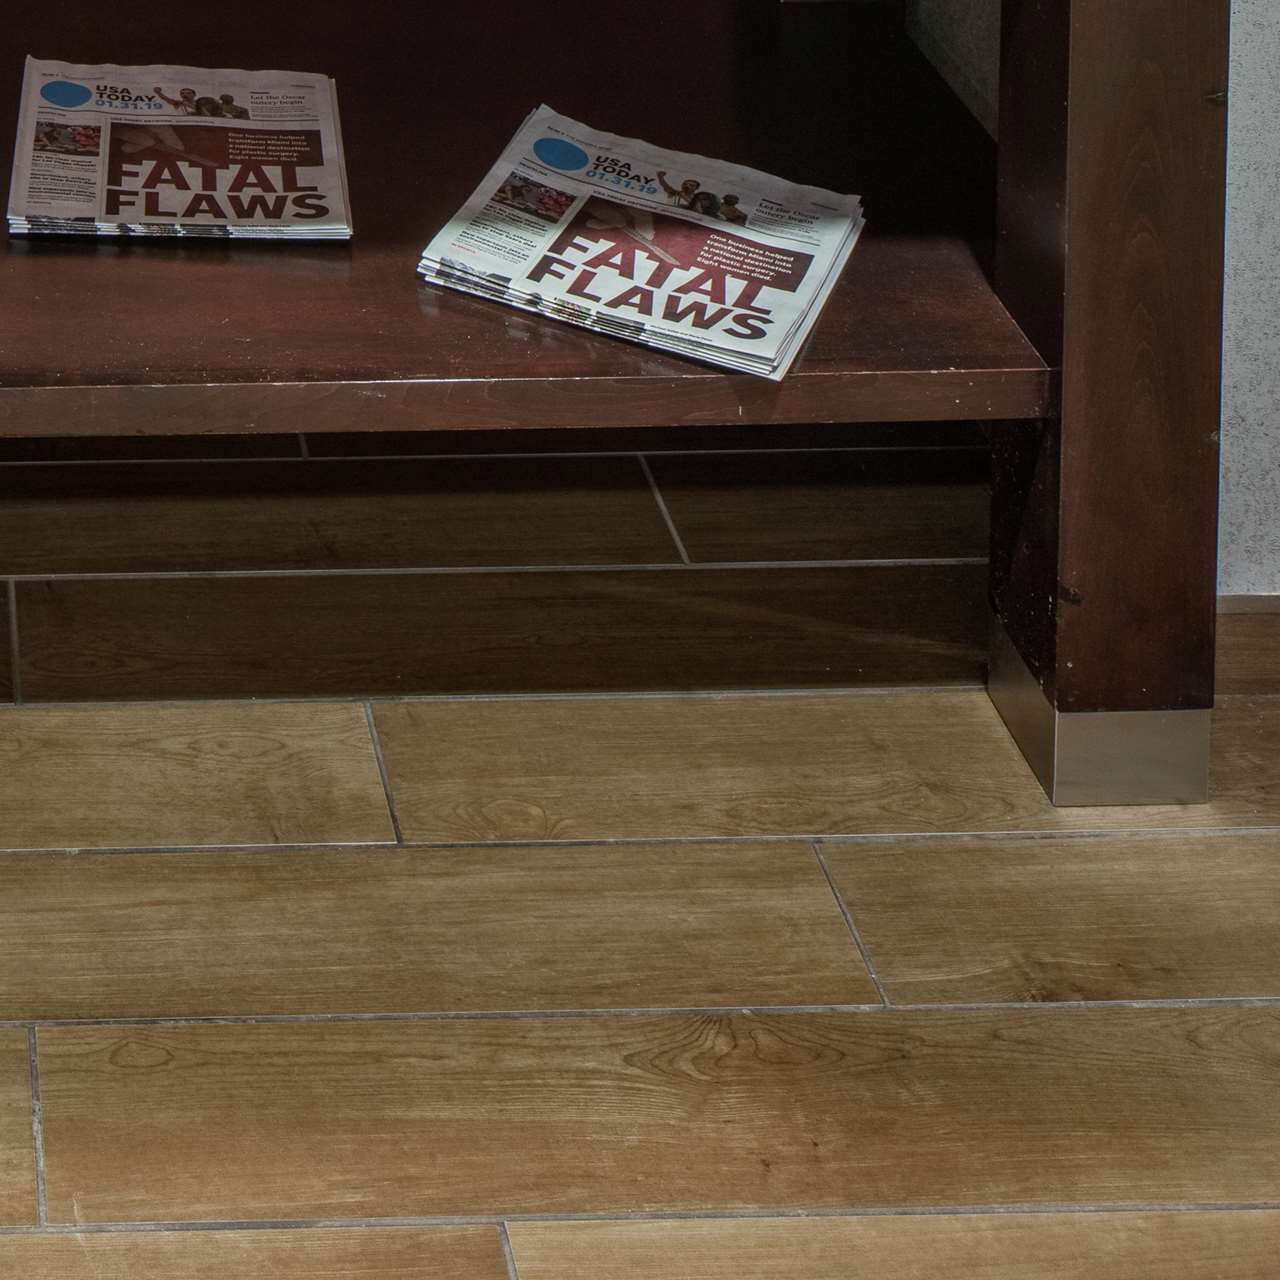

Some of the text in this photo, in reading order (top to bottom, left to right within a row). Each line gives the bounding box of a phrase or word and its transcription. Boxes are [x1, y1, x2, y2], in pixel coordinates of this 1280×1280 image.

[96, 85, 132, 95] USA
[96, 92, 157, 103] TODAY
[95, 99, 163, 110] 01.31.19
[592, 163, 656, 185] TODAY
[595, 155, 632, 171] USA
[108, 159, 318, 192] FATAL
[586, 170, 658, 194] 01.31.19
[105, 188, 330, 220] FLAWS
[544, 234, 775, 316] FATAL
[525, 255, 775, 341] FLAWS
